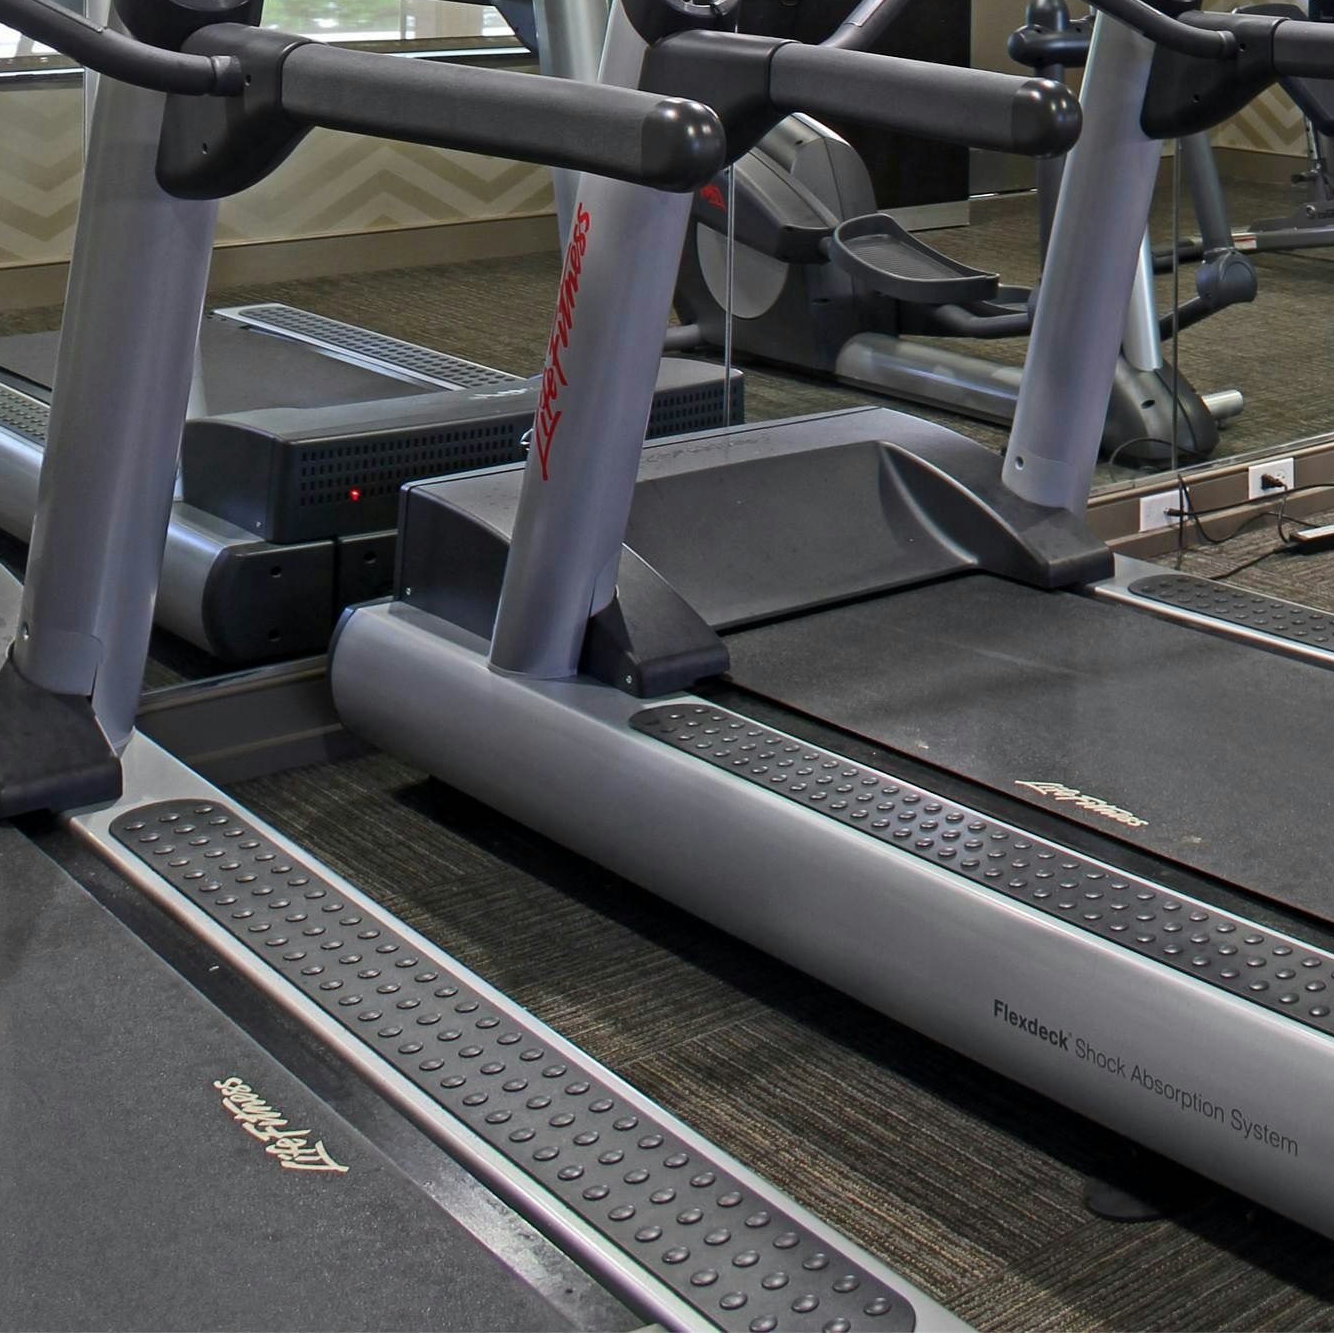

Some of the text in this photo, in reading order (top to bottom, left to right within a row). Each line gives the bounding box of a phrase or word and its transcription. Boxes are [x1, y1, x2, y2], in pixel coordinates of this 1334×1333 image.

[994, 999, 1299, 1157] Flexdeck Shock Absorption System
